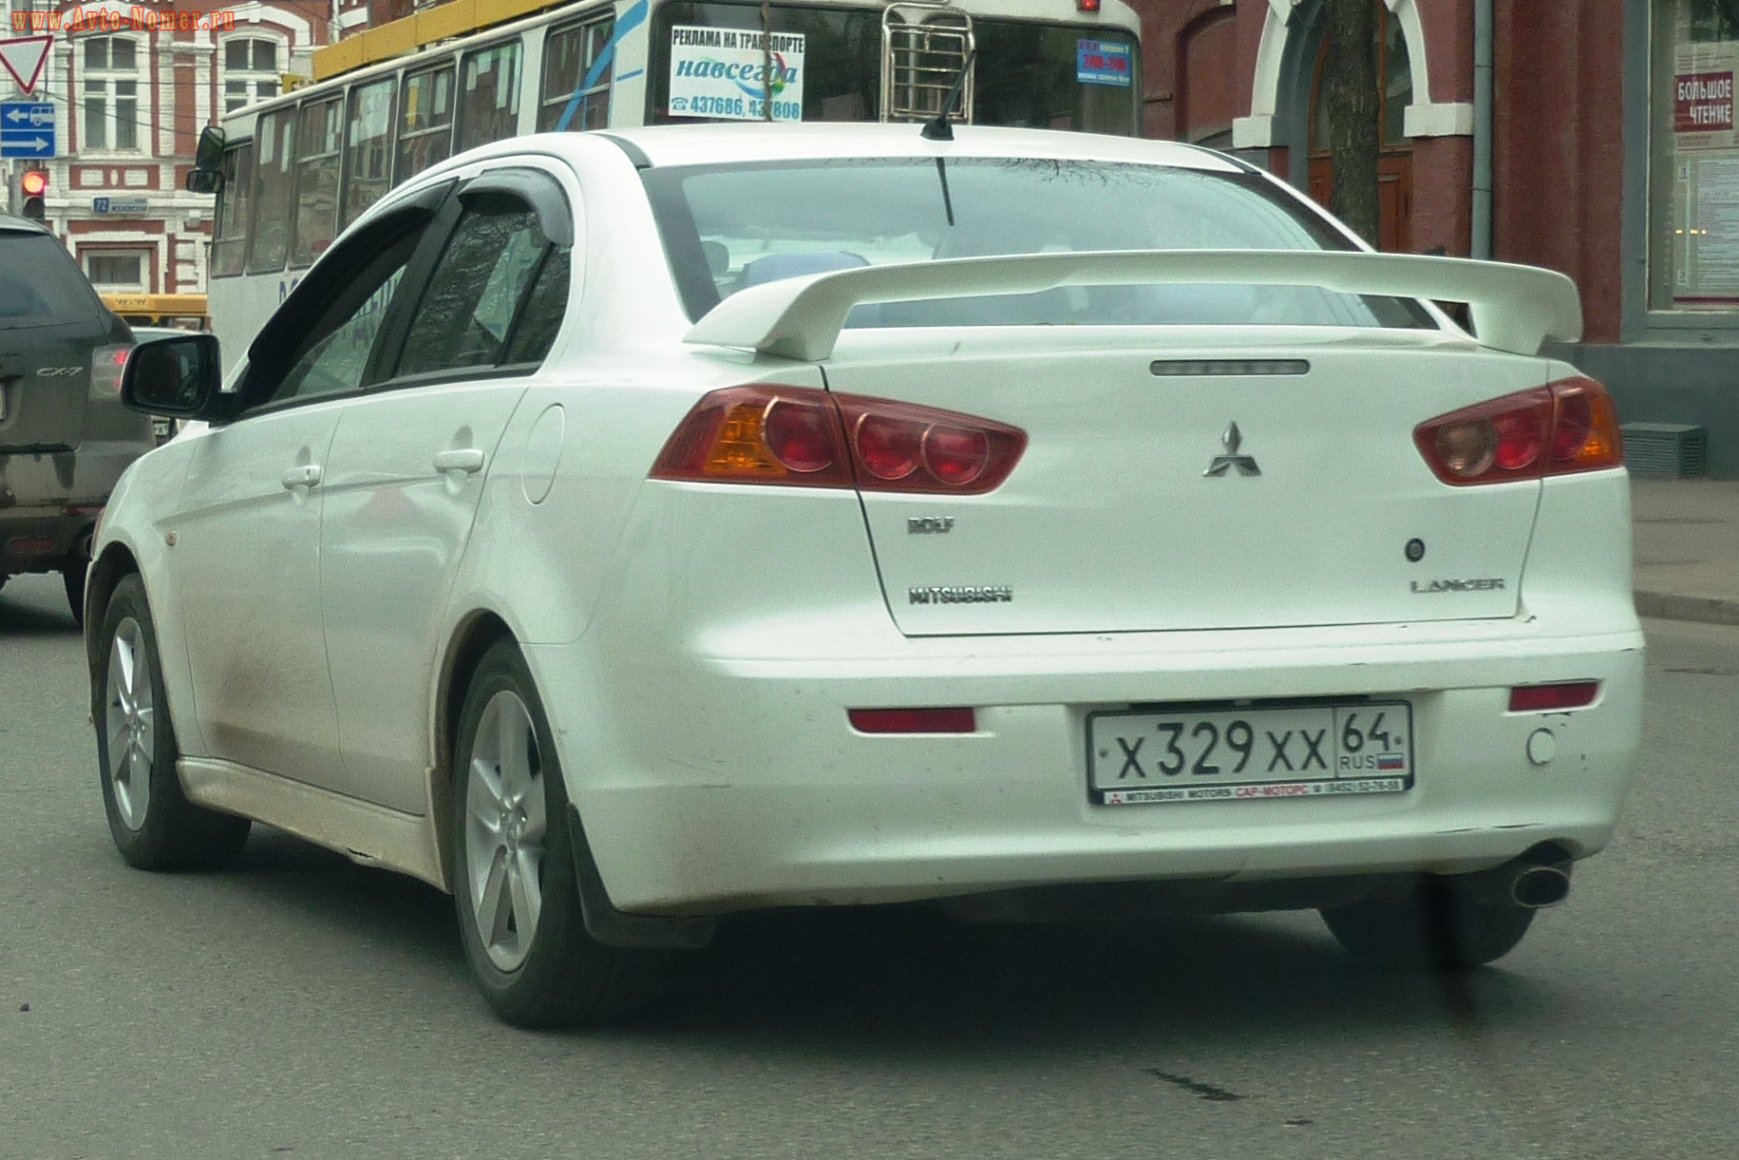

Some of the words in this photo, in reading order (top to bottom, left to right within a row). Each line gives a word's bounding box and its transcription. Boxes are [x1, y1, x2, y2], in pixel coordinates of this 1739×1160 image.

[673, 29, 720, 47] РЕКЛАМА
[723, 32, 738, 49] НА
[1678, 79, 1731, 101] БОЛЬШОЕ
[690, 96, 745, 117] 437686,
[749, 99, 800, 119] 43808
[1689, 104, 1731, 124] ЧТЕНИЕ
[36, 366, 84, 376] CX-7
[1411, 578, 1504, 593] LANCER
[909, 586, 1013, 605] MITSUBISHI
[1342, 712, 1391, 752] 64
[1338, 754, 1376, 770] RUS
[1126, 790, 1184, 801] MITSUBISHI
[1187, 788, 1232, 799] MOTORS
